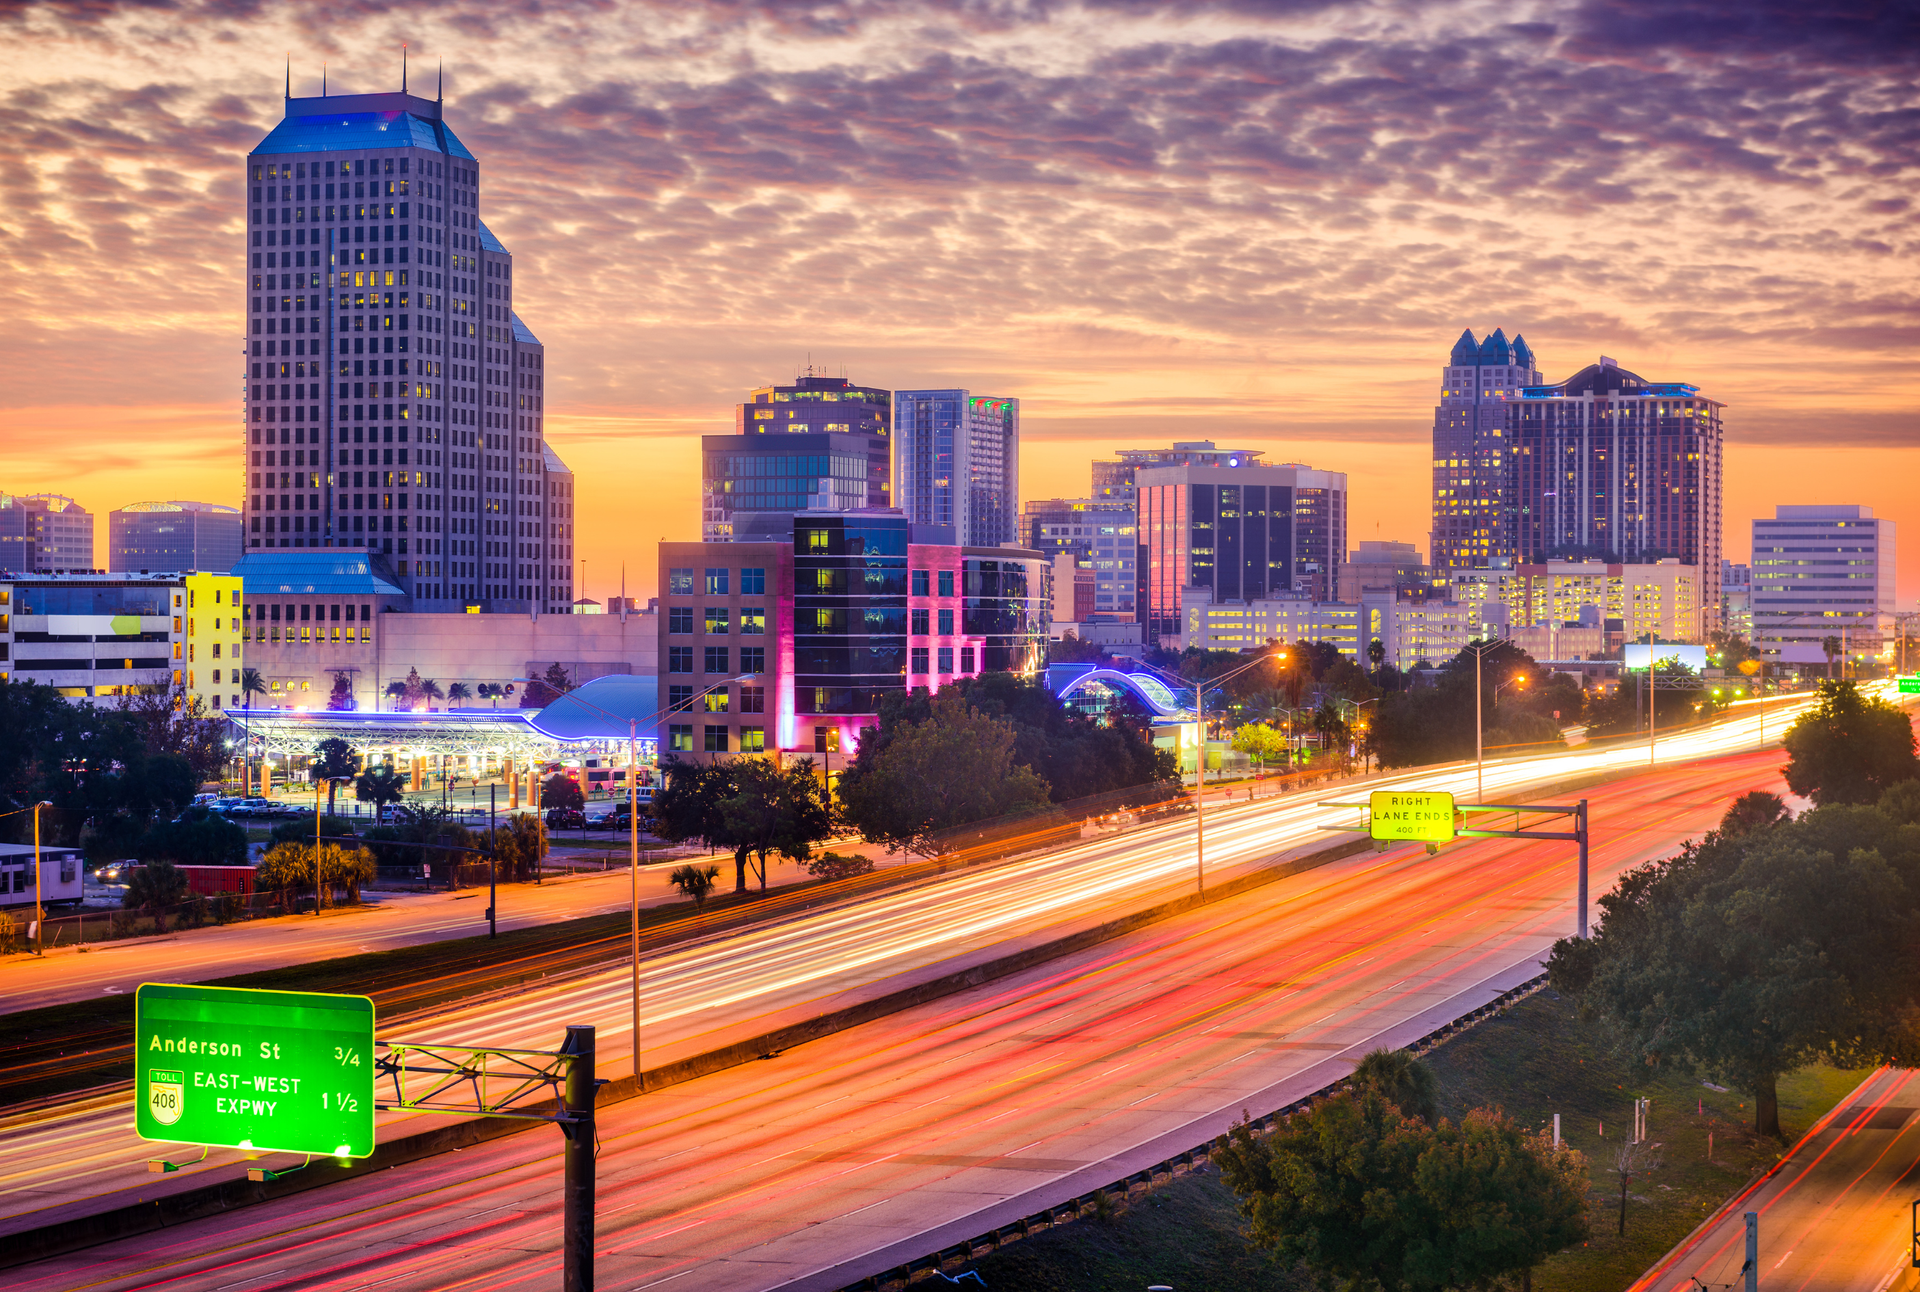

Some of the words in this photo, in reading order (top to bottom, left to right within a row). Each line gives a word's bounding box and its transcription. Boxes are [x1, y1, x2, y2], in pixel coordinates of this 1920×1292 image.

[1392, 797, 1431, 806] RIGHT
[1374, 811, 1409, 820] LANE
[1415, 812, 1450, 821] ENDS
[1396, 826, 1413, 834] 400
[1417, 826, 1427, 834] FT
[150, 1034, 242, 1057] Anderson
[260, 1041, 281, 1060] St
[155, 1072, 178, 1082] TOLL
[194, 1071, 301, 1094] EAST-WEST
[152, 1092, 176, 1109] 408
[216, 1097, 277, 1117] EXPWY
